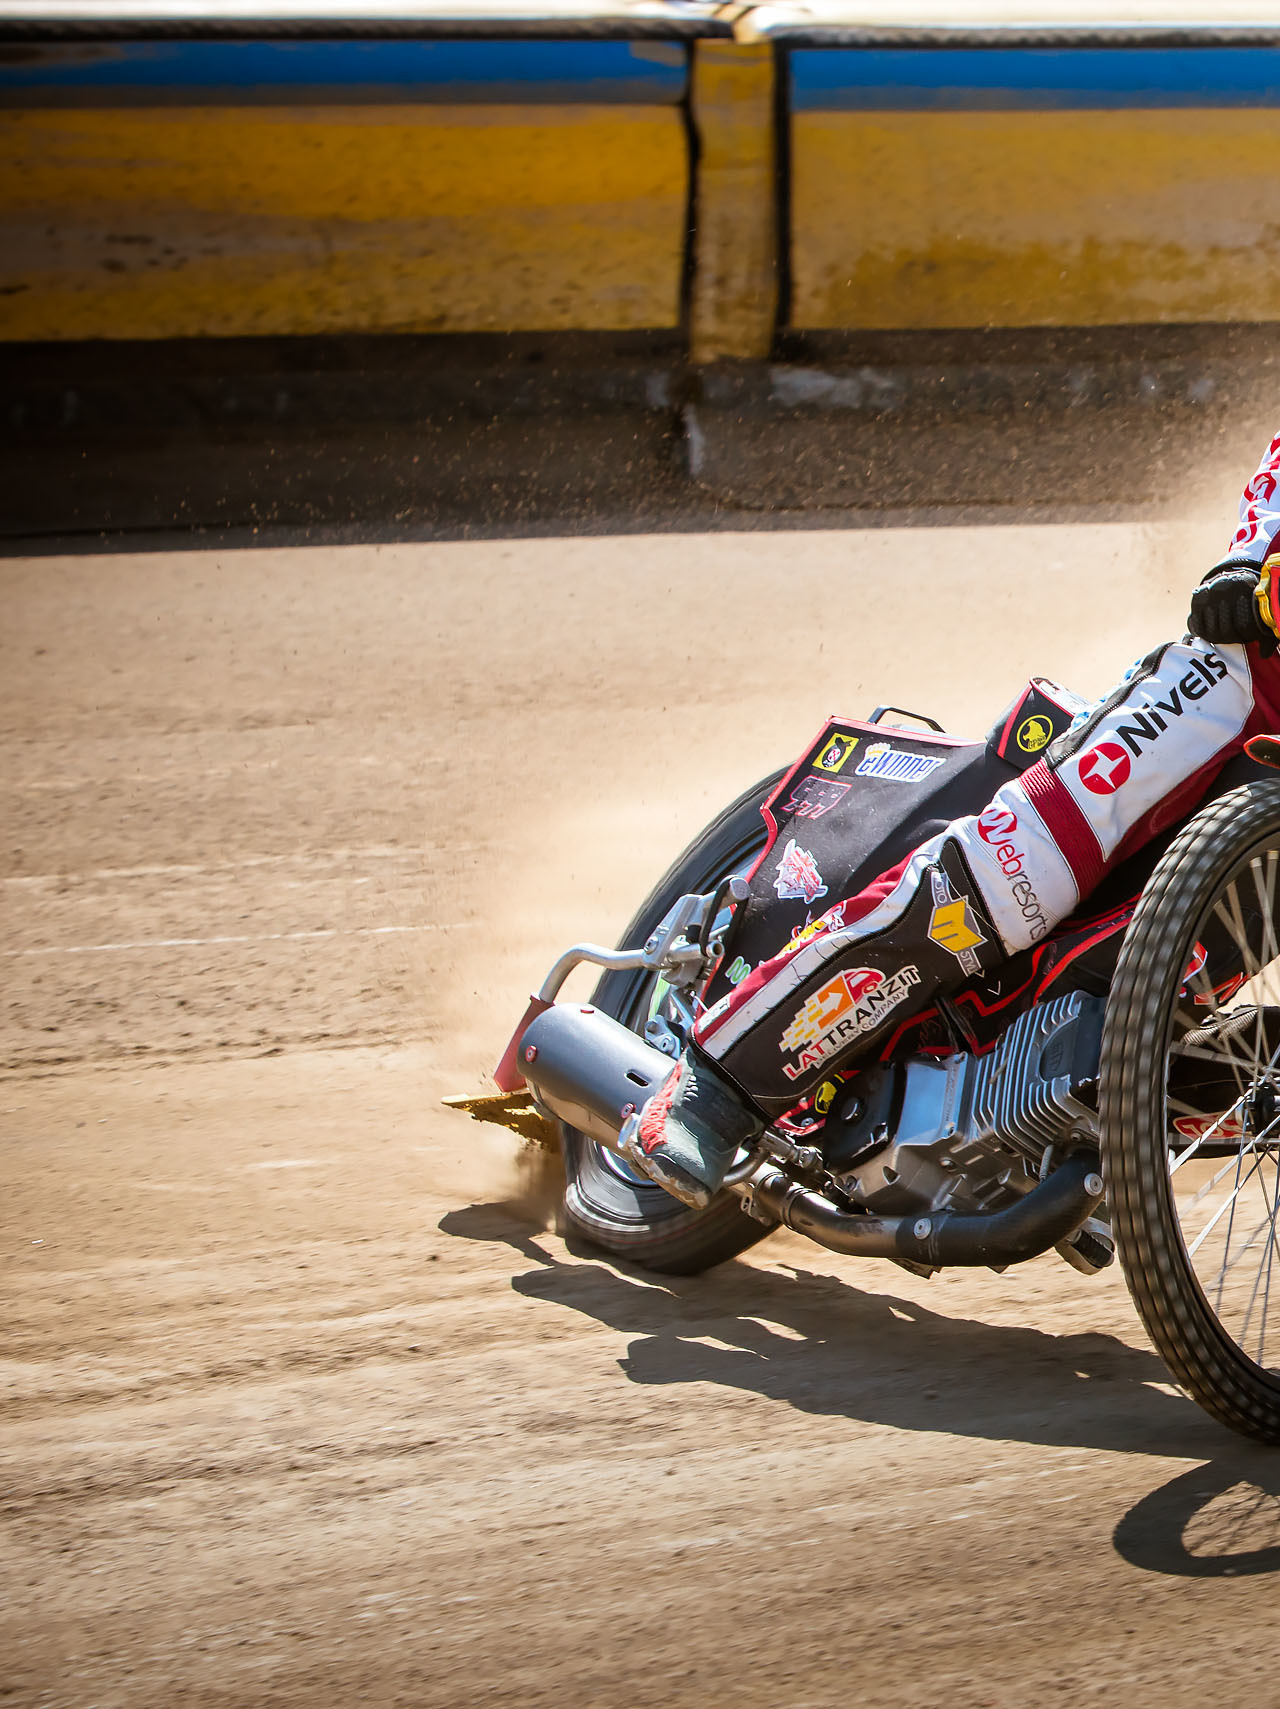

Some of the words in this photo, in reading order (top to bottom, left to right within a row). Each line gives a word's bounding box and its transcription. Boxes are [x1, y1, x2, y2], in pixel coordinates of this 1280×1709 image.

[1115, 652, 1228, 758] Nivels
[857, 750, 942, 780] eWinner
[785, 966, 919, 1079] LATTRANZIT
[862, 990, 907, 1030] COMPANY
